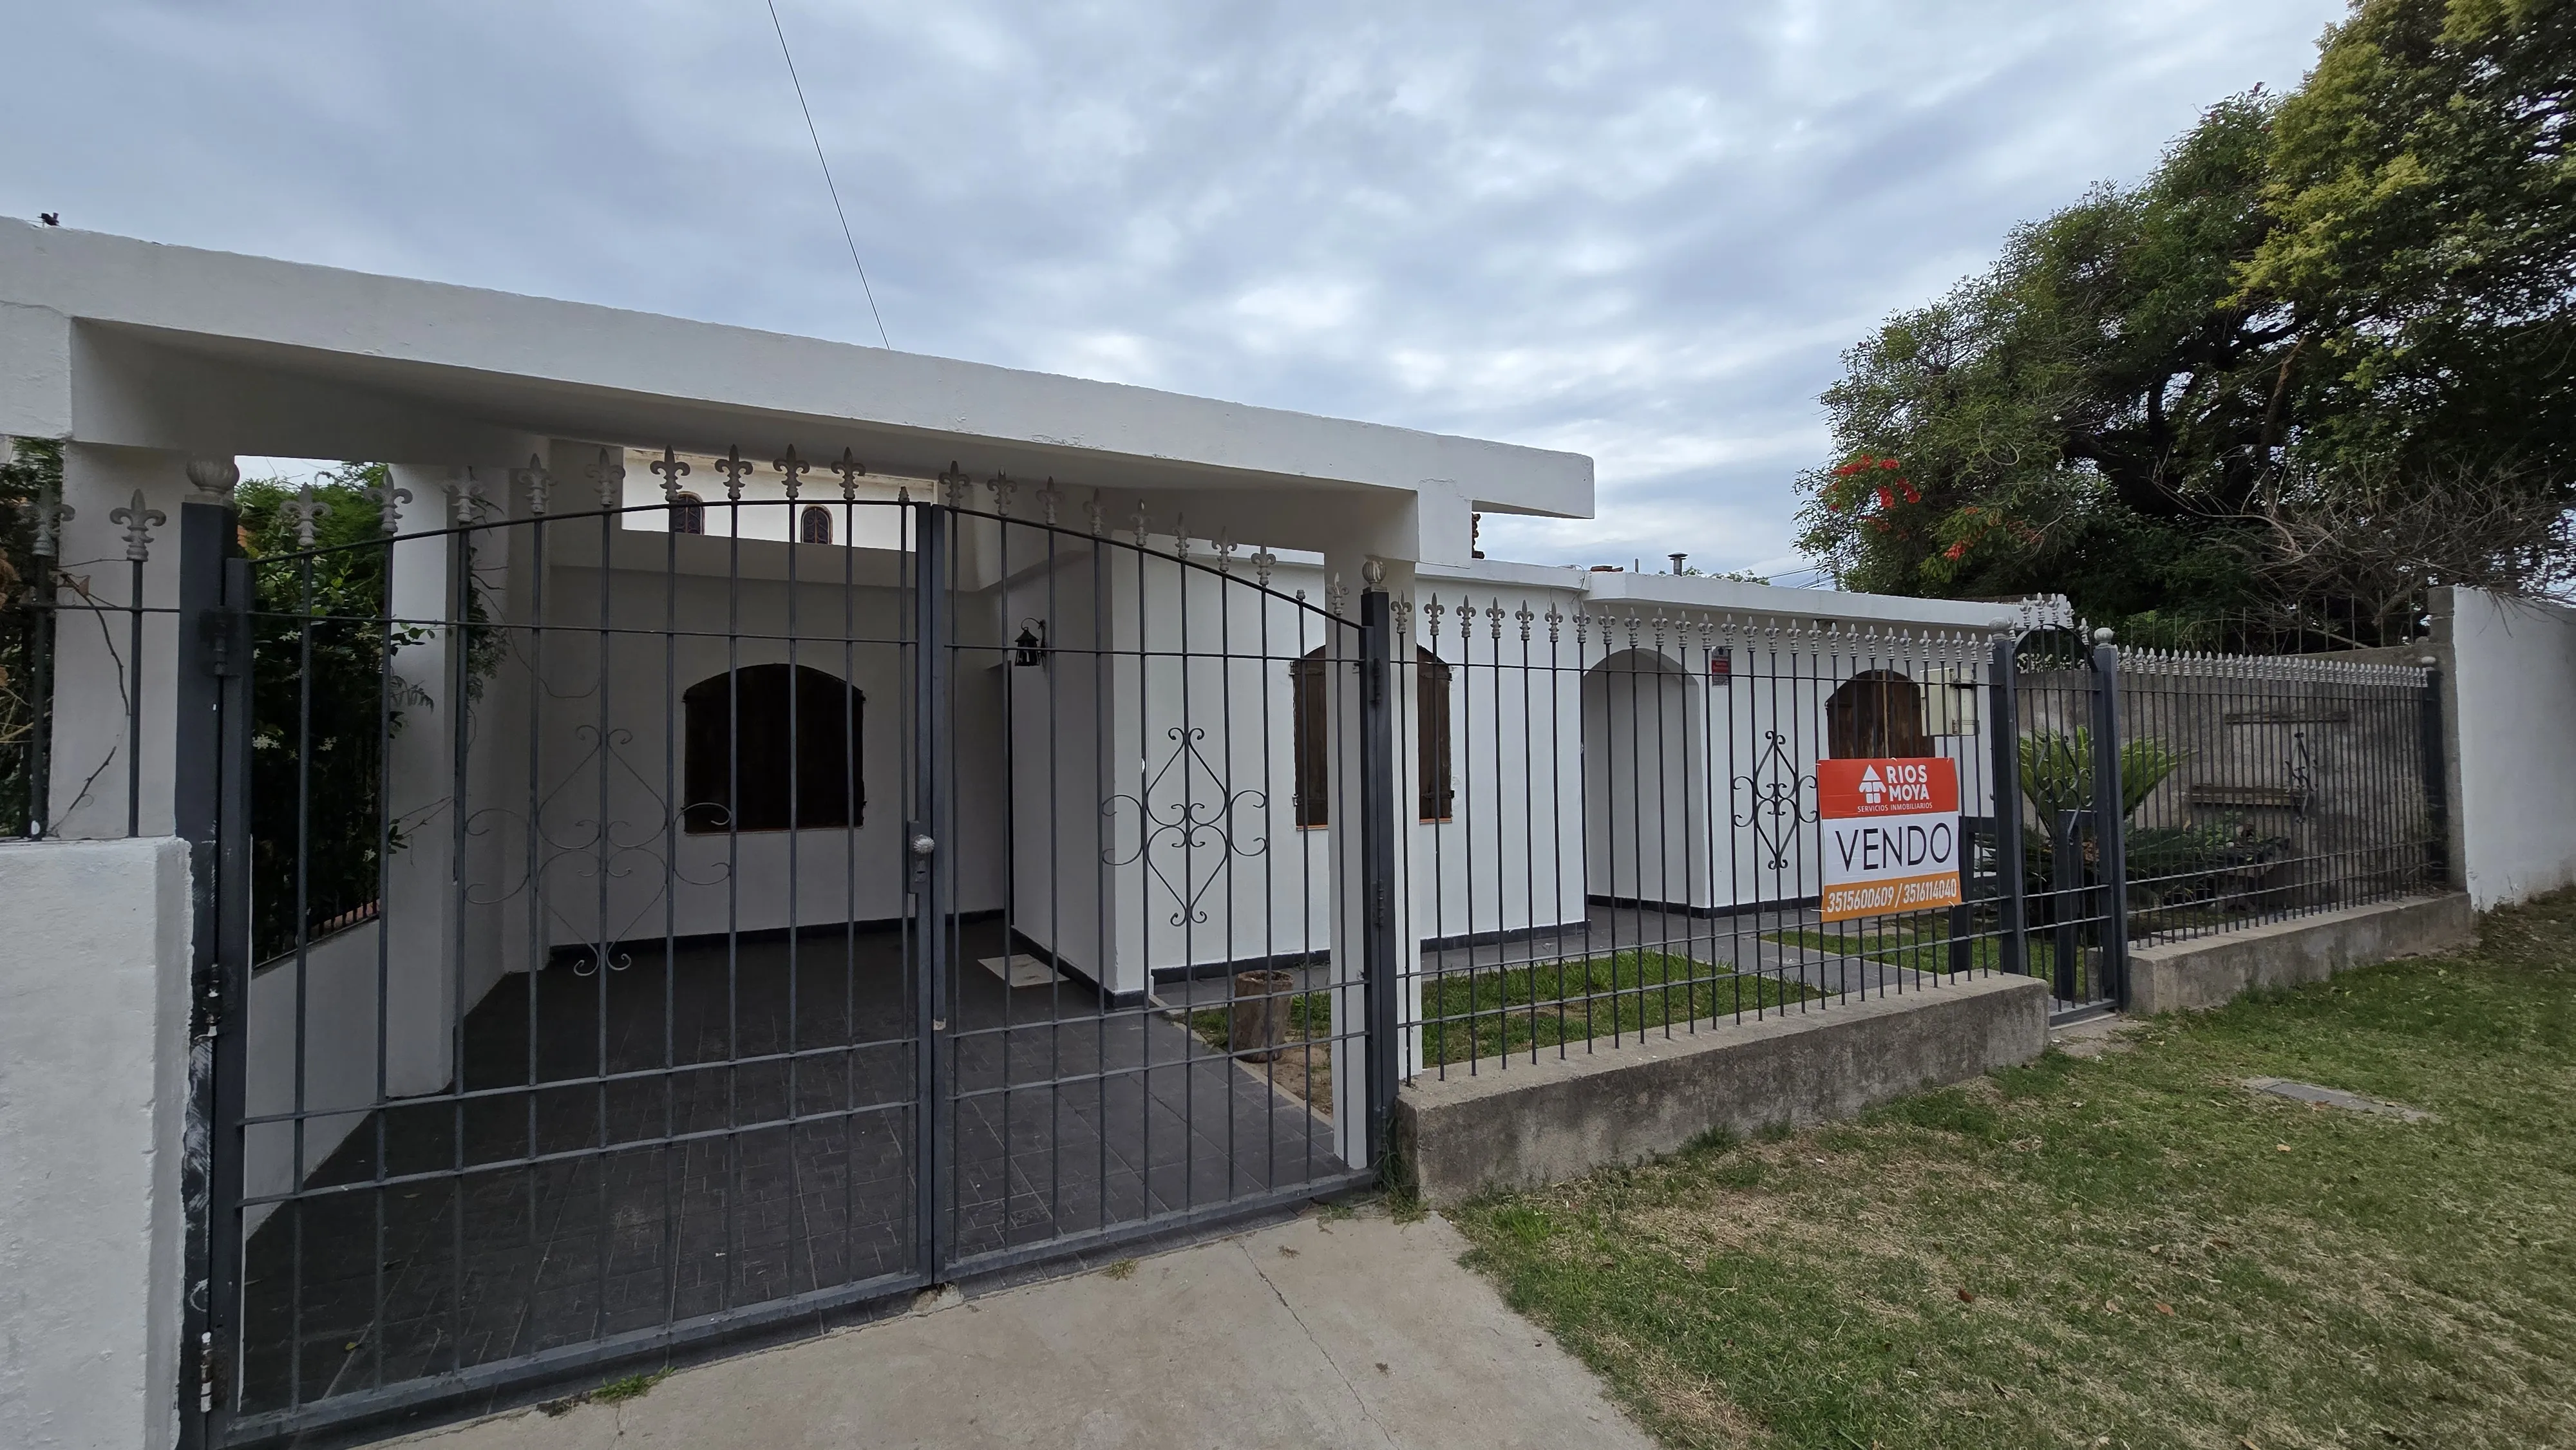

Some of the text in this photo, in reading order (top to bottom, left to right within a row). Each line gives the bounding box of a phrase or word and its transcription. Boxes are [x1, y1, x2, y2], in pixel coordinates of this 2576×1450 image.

[1886, 764, 1927, 784] RIOS
[1888, 784, 1930, 802] MOYA
[1857, 802, 1933, 813] SERVICIOS INMOBILIARIOS
[1835, 822, 1951, 872] VENDO
[1827, 886, 1894, 913] 3515600609
[1903, 878, 1957, 904] 3516114040
